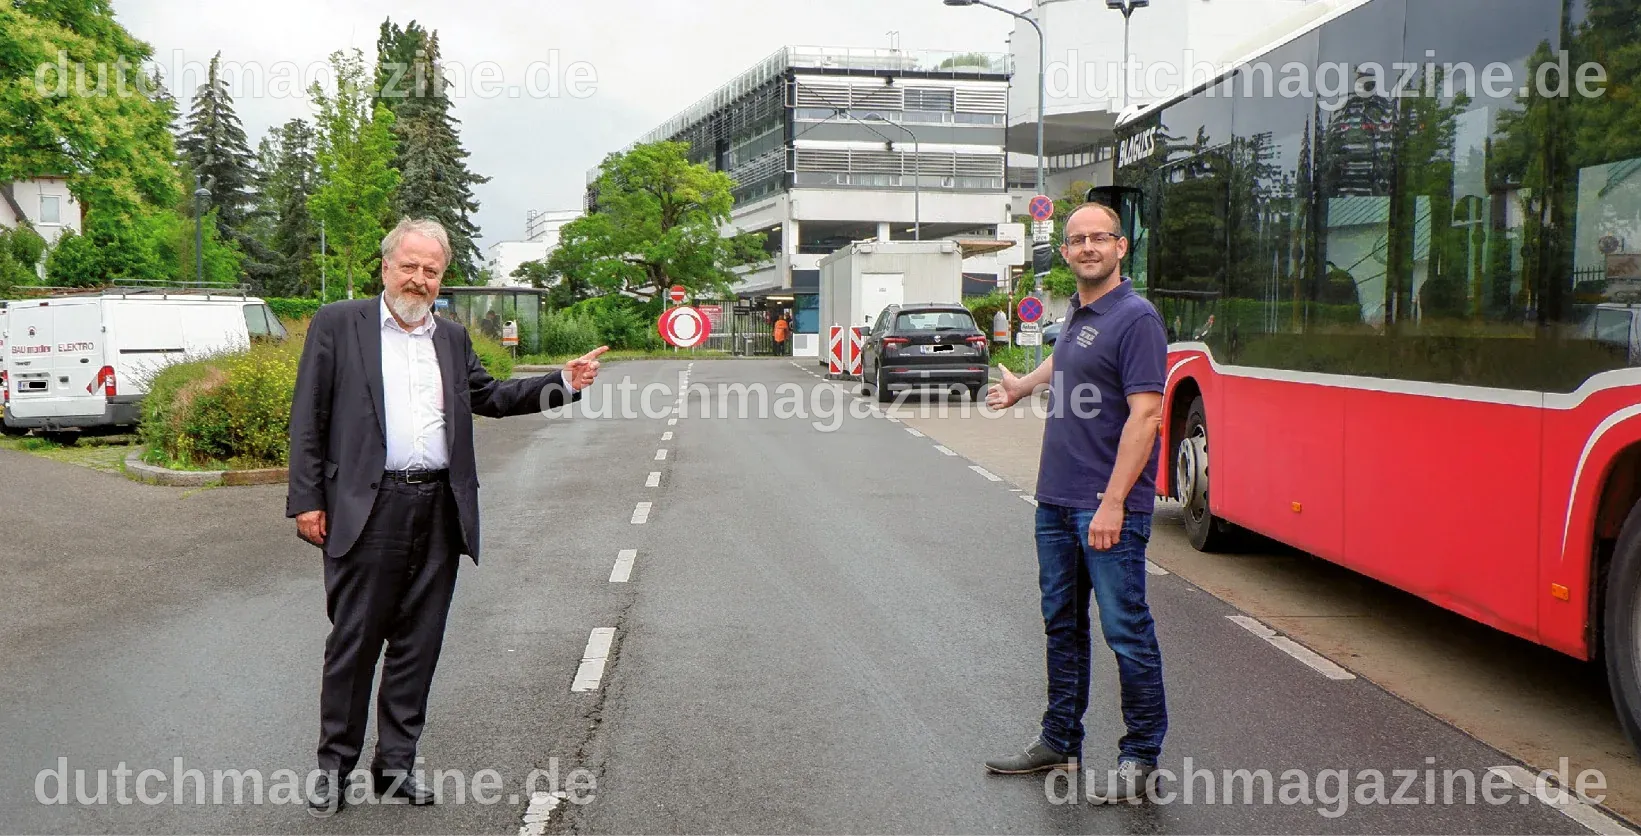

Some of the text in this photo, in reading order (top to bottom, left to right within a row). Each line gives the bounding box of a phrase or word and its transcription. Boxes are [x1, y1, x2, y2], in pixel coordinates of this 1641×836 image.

[1118, 126, 1156, 168] BLAGUSS
[12, 346, 26, 354] BAU
[58, 342, 94, 352] ELEKTRO
